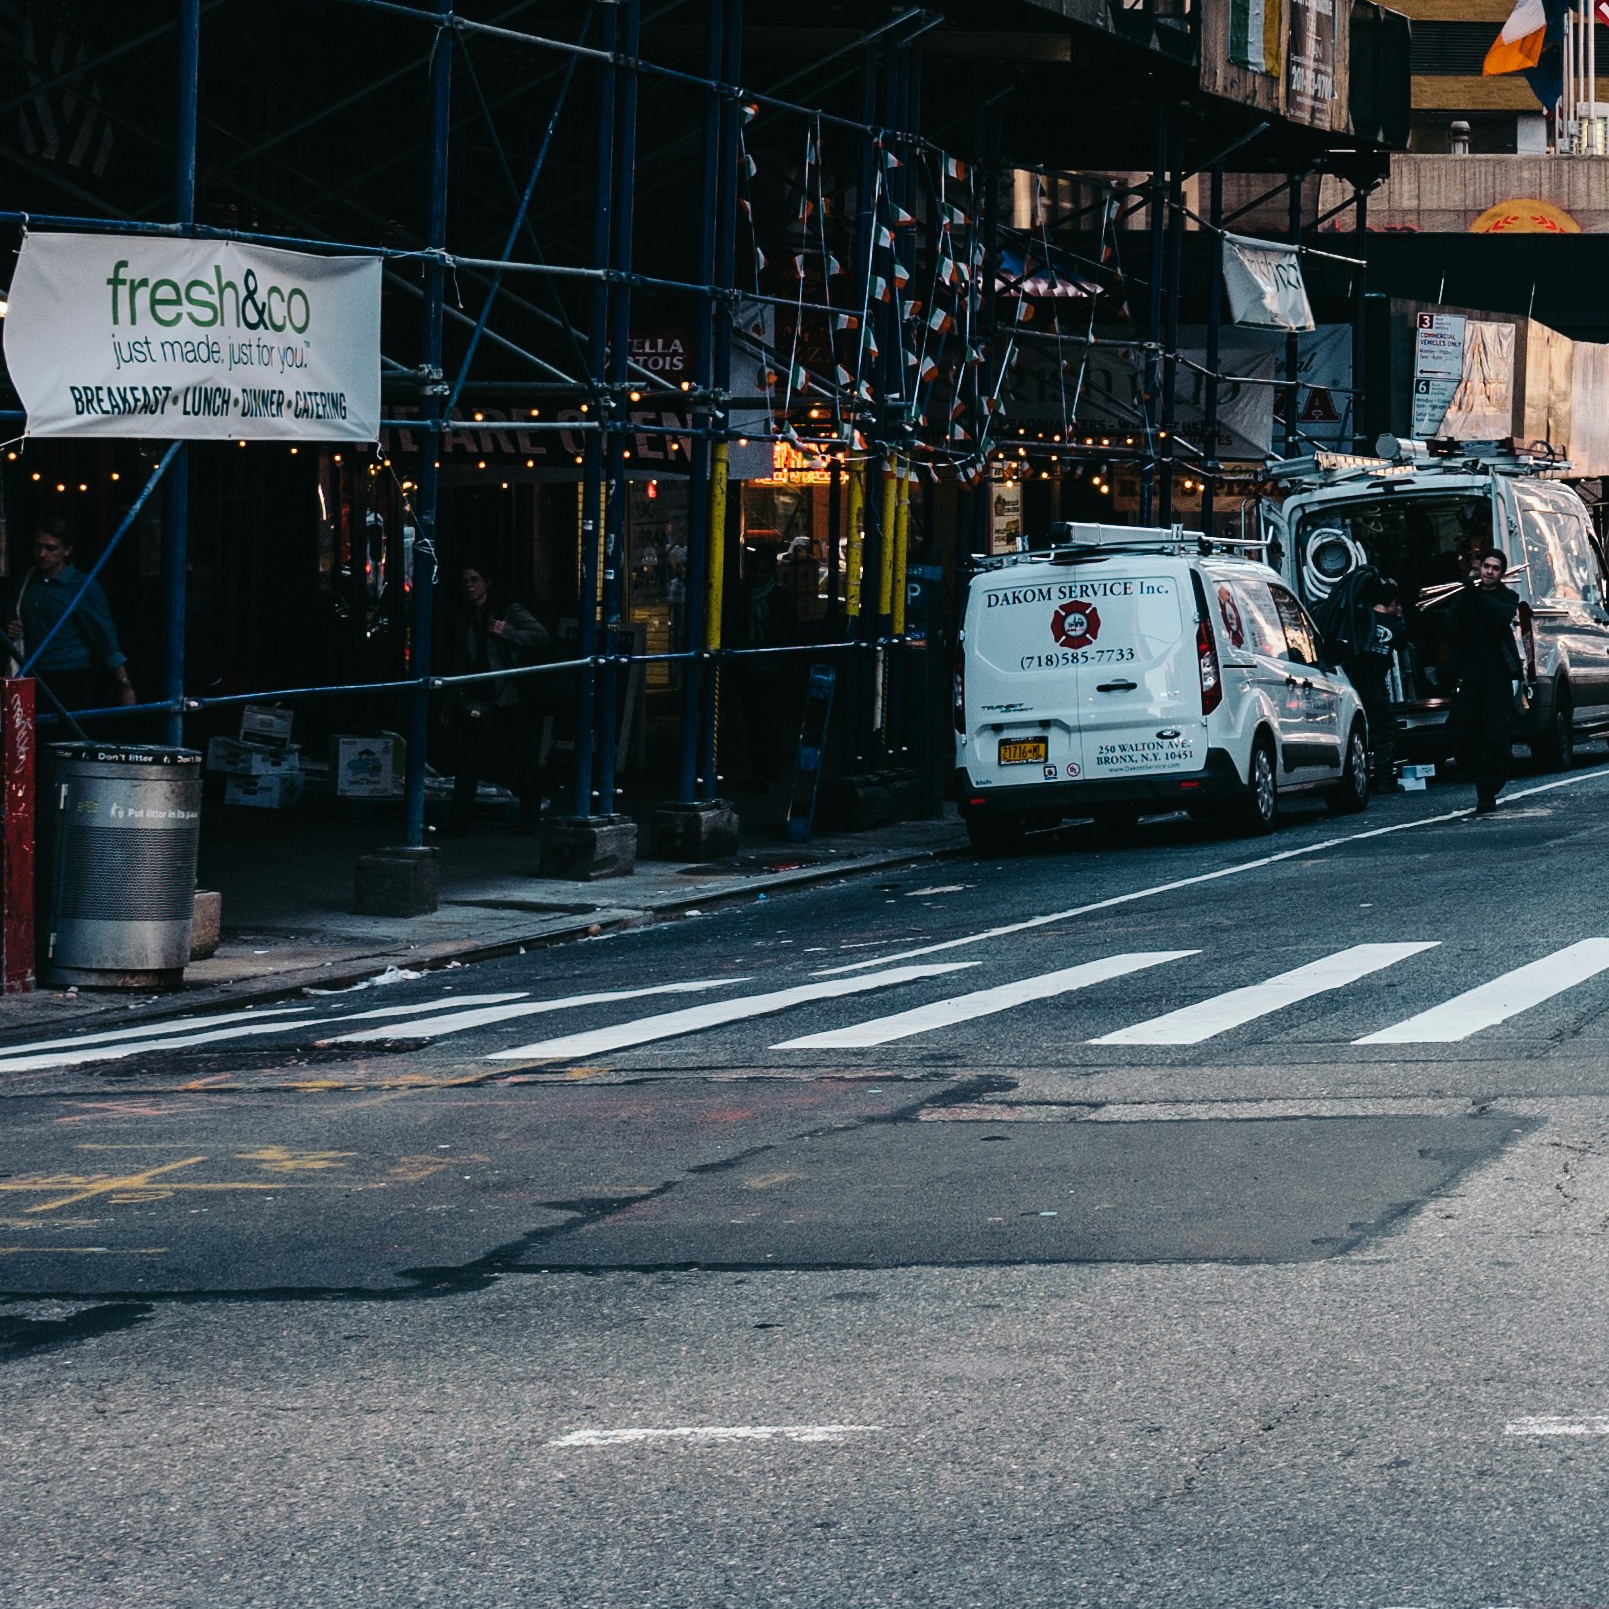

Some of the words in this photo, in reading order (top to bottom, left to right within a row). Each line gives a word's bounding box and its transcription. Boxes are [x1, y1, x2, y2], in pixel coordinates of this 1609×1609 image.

[106, 259, 311, 335] fresh&co
[1421, 315, 1432, 329] 3
[1420, 331, 1456, 341] COMMERCIAL
[1420, 339, 1446, 348] VEHICLES
[1447, 340, 1462, 349] ONLY
[111, 334, 156, 370] just
[161, 339, 226, 366] made.
[228, 337, 253, 372] just
[257, 337, 275, 368] for
[1419, 381, 1428, 394] 6
[69, 386, 173, 416] BREAKFAST
[182, 384, 232, 417] LUNCH
[240, 388, 285, 419] DINNER
[293, 390, 347, 420] CATERING
[987, 589, 1052, 609] DAKOM
[1057, 581, 1134, 600] SERVICE
[1138, 580, 1169, 596] Inc.
[1020, 647, 1135, 671] (718)585-7733
[1098, 744, 1116, 756] 250
[1118, 742, 1164, 754] WALTON
[1166, 740, 1191, 752] AVE.
[97, 751, 125, 762] Don't
[128, 753, 155, 763] litter
[1096, 755, 1138, 766] BRONX,
[1140, 752, 1162, 763] N.Y.
[1164, 750, 1194, 761] 10451
[1108, 761, 1181, 774] www.DakomService.com
[127, 808, 144, 819] Put
